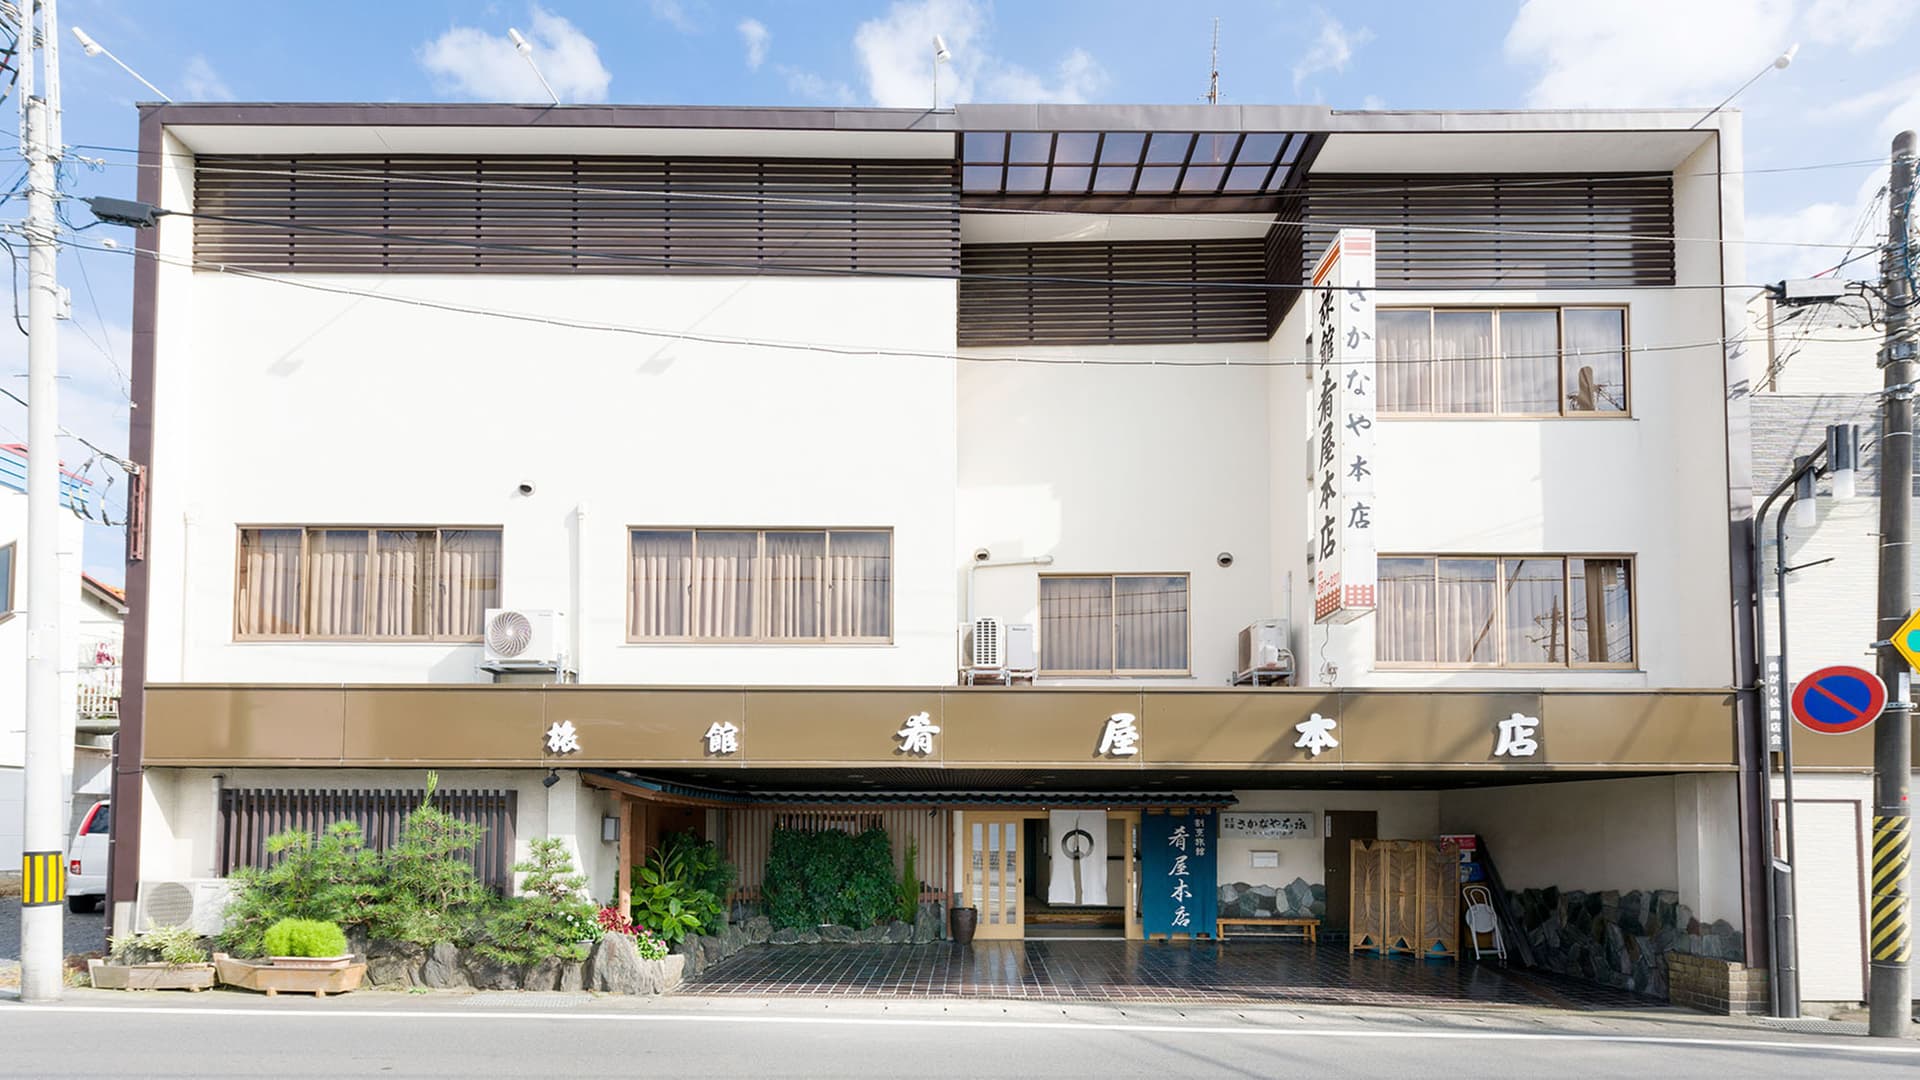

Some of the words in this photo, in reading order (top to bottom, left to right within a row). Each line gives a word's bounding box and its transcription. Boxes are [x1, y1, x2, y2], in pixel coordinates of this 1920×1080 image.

[1317, 280, 1337, 562] 旅館肴屋本店
[1345, 280, 1371, 529] さかなや本店
[546, 712, 1540, 757] 旅館肴屋本店
[1168, 825, 1193, 927] 肴屋本店
